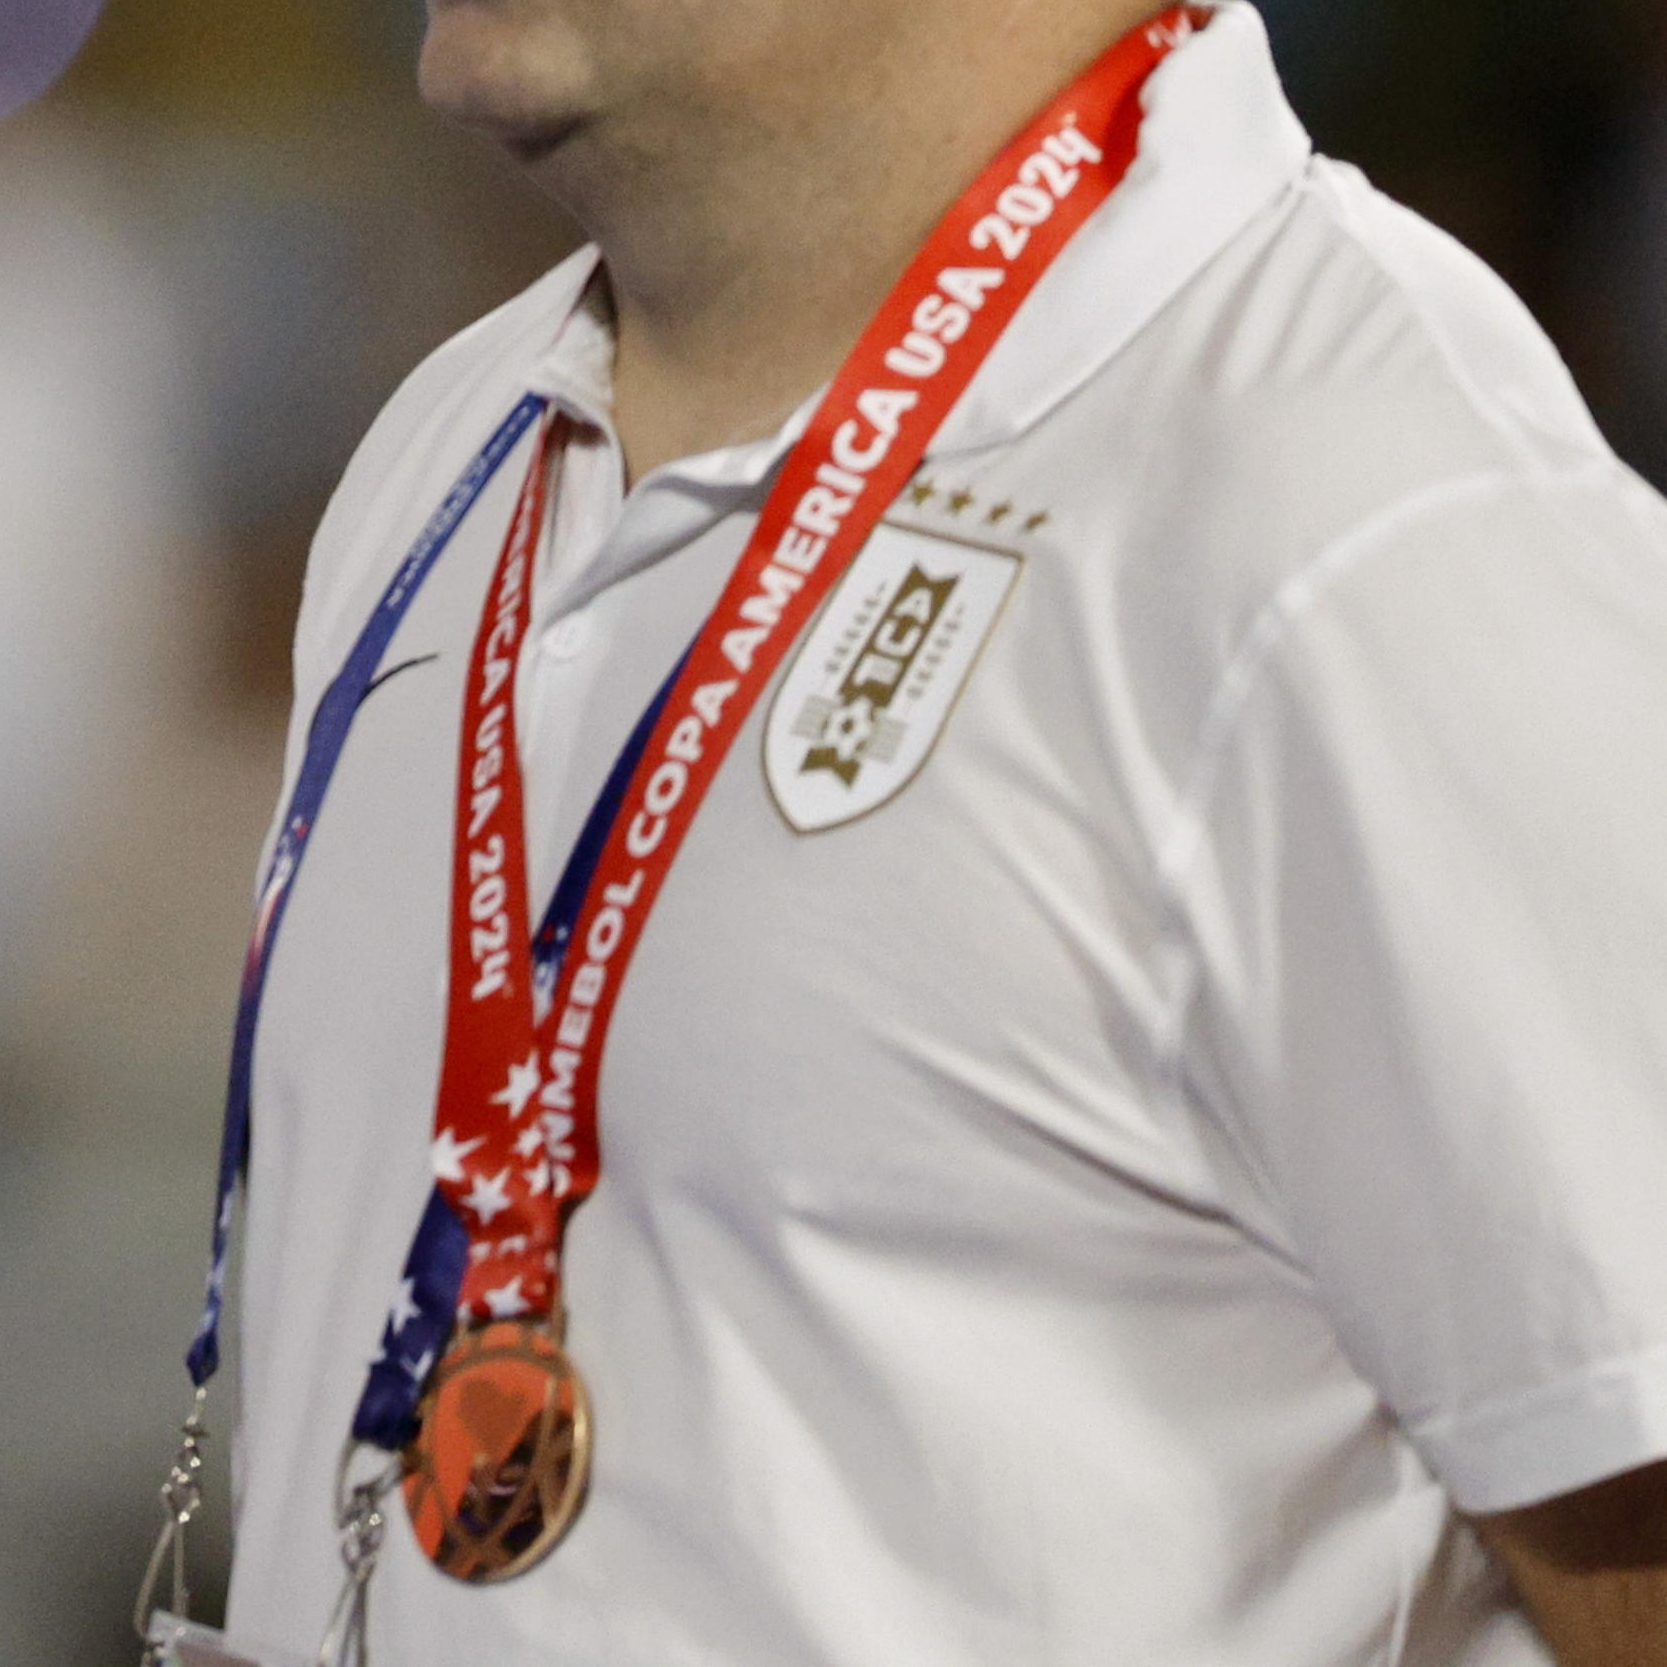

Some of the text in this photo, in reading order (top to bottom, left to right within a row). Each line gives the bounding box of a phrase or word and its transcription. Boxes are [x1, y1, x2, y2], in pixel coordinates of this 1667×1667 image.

[626, 679, 739, 858] COPA
[720, 388, 921, 673] AMERICA
[884, 266, 1006, 378] USA
[968, 122, 1103, 262] 2024
[468, 701, 508, 838] USA
[469, 836, 512, 1001] 2024
